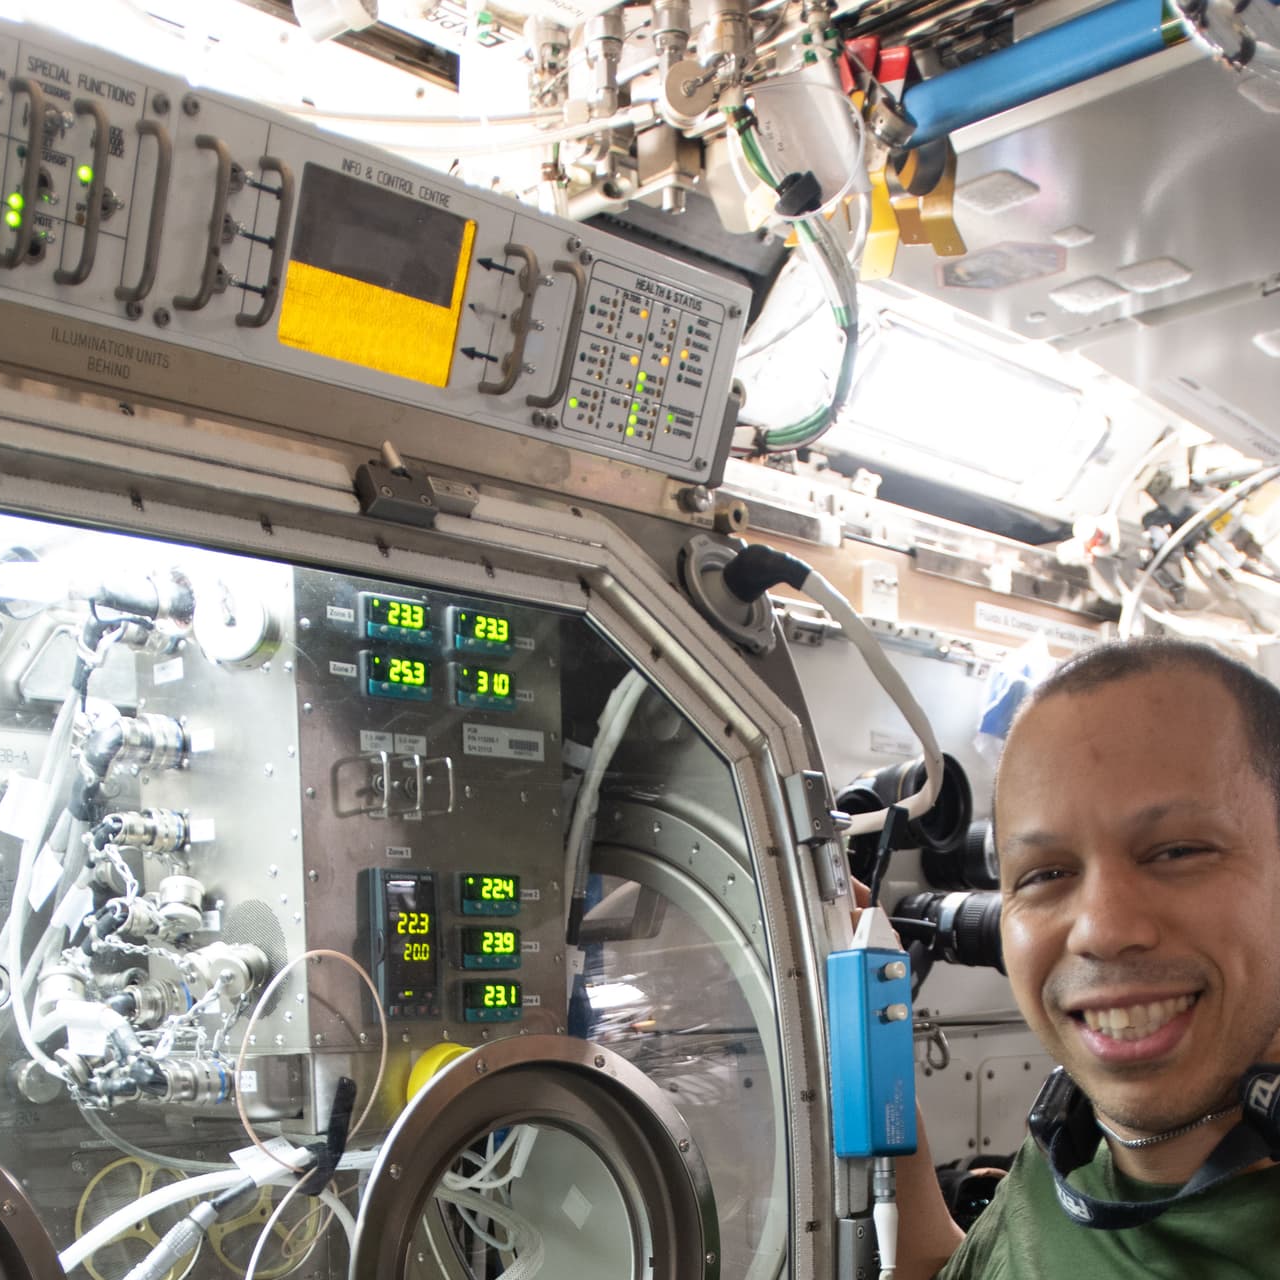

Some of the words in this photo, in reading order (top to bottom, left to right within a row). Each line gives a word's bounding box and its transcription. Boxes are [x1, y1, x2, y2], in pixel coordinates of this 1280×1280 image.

[27, 56, 70, 84] SPECIAL
[77, 74, 137, 107] FUNCTIONS
[341, 158, 362, 176] INFO
[365, 166, 373, 180] &
[376, 170, 414, 196] CONTROL
[419, 186, 452, 208] CENTRE
[635, 278, 665, 297] HEALTH
[673, 290, 703, 312] STATUS
[50, 326, 134, 360] ILLUMINATION
[135, 347, 170, 369] UNITS
[87, 355, 131, 379] BEHIND
[388, 848, 405, 857] Zone
[481, 877, 514, 899] 22.4
[397, 911, 430, 935] 22.3
[403, 943, 430, 961] 20.0
[482, 931, 515, 953] 23.9
[484, 985, 516, 1007] 23.1
